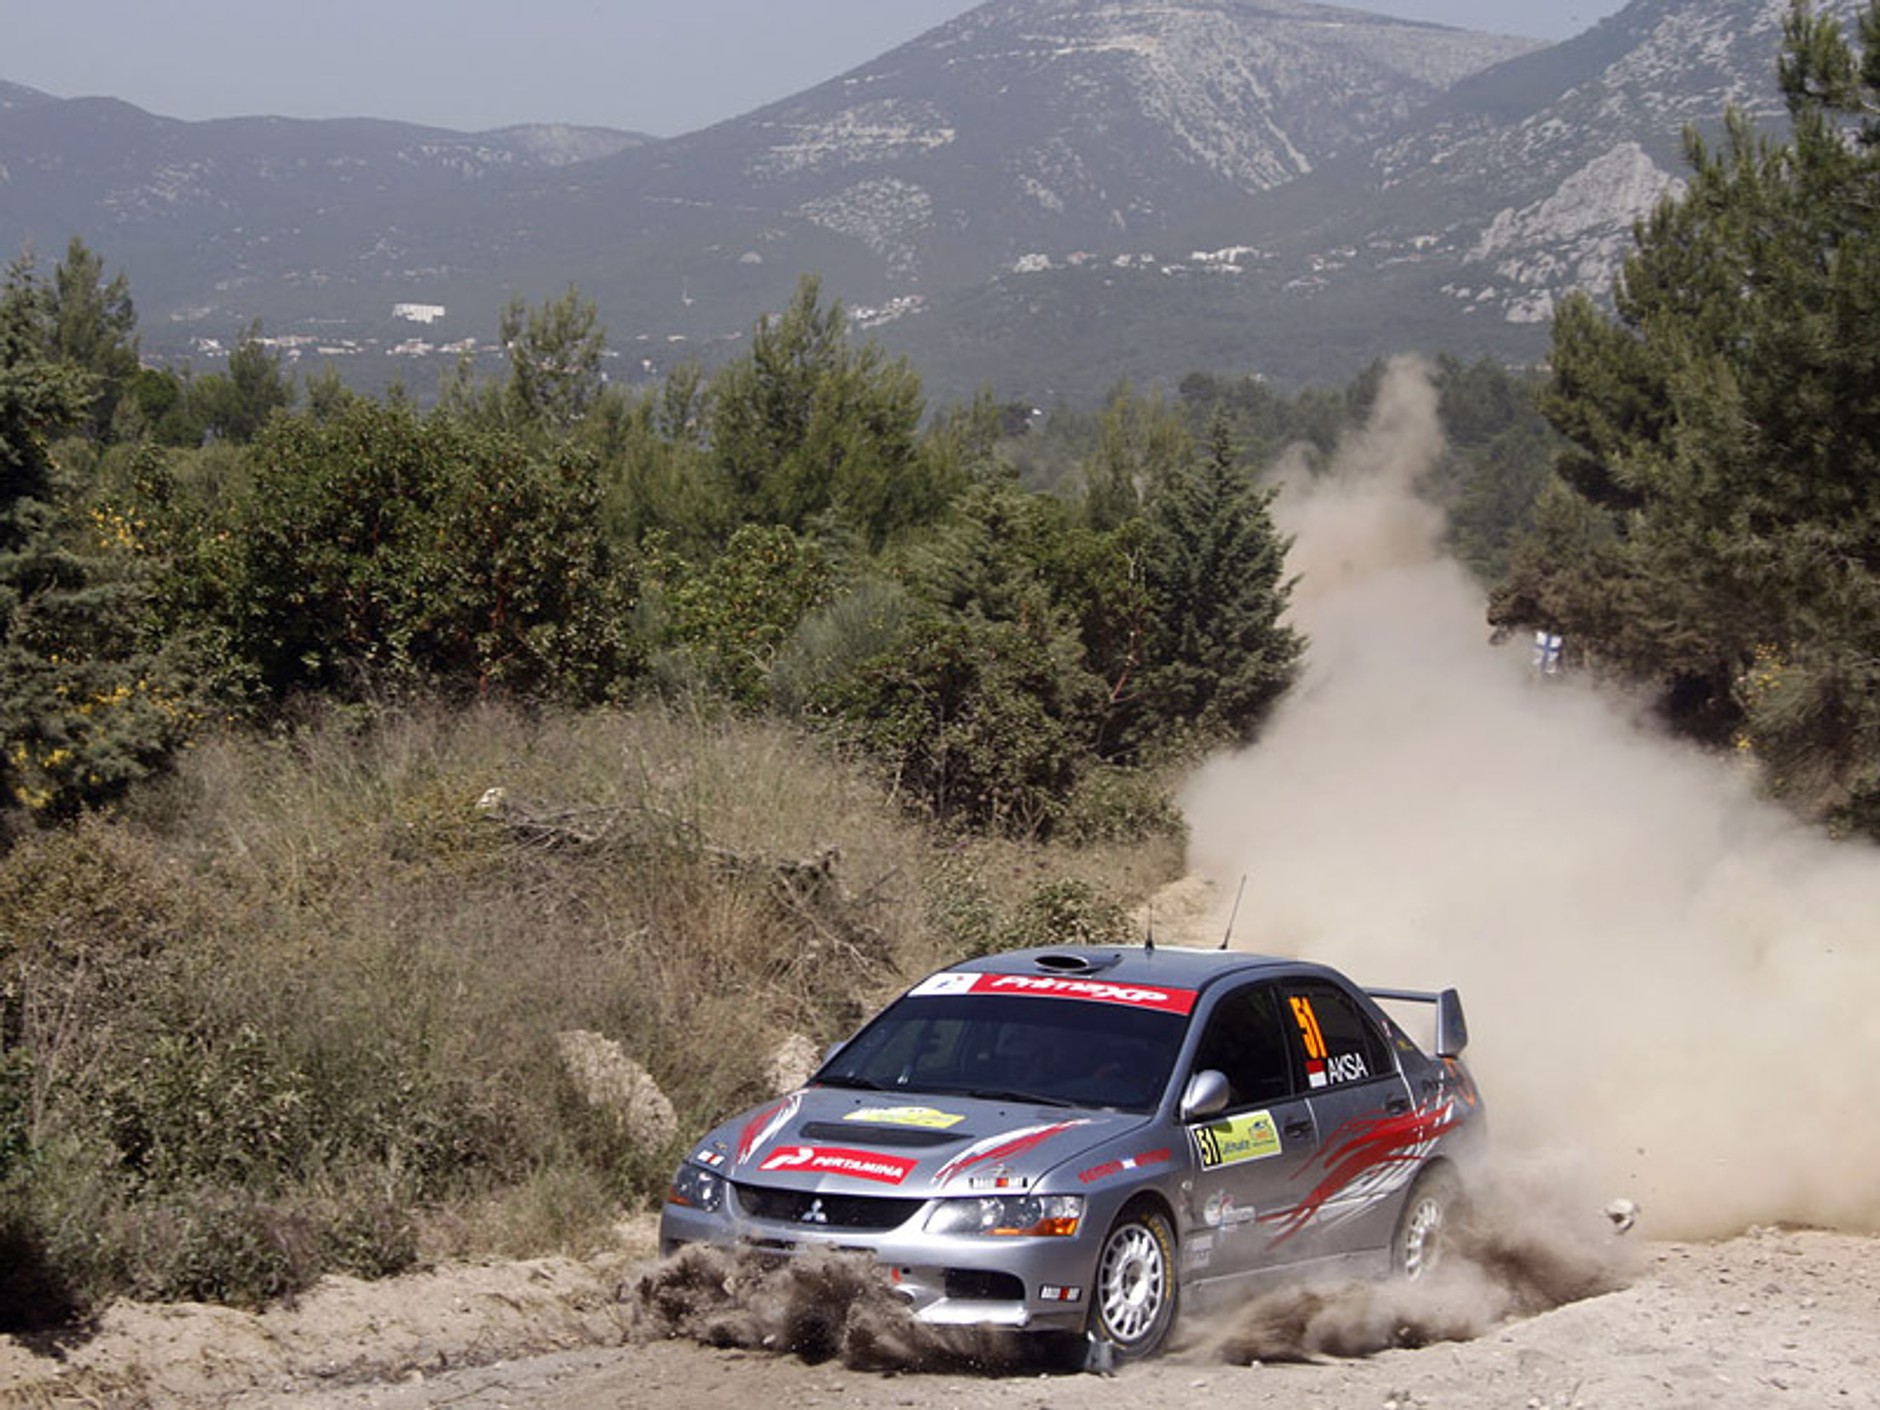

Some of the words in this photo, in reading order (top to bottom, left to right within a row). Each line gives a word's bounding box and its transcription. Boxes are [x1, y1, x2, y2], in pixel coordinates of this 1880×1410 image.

[1289, 996, 1328, 1060] 51
[1327, 1053, 1369, 1085] AKSA
[1195, 1127, 1219, 1165] 51
[811, 1156, 904, 1178] PERTAMINA
